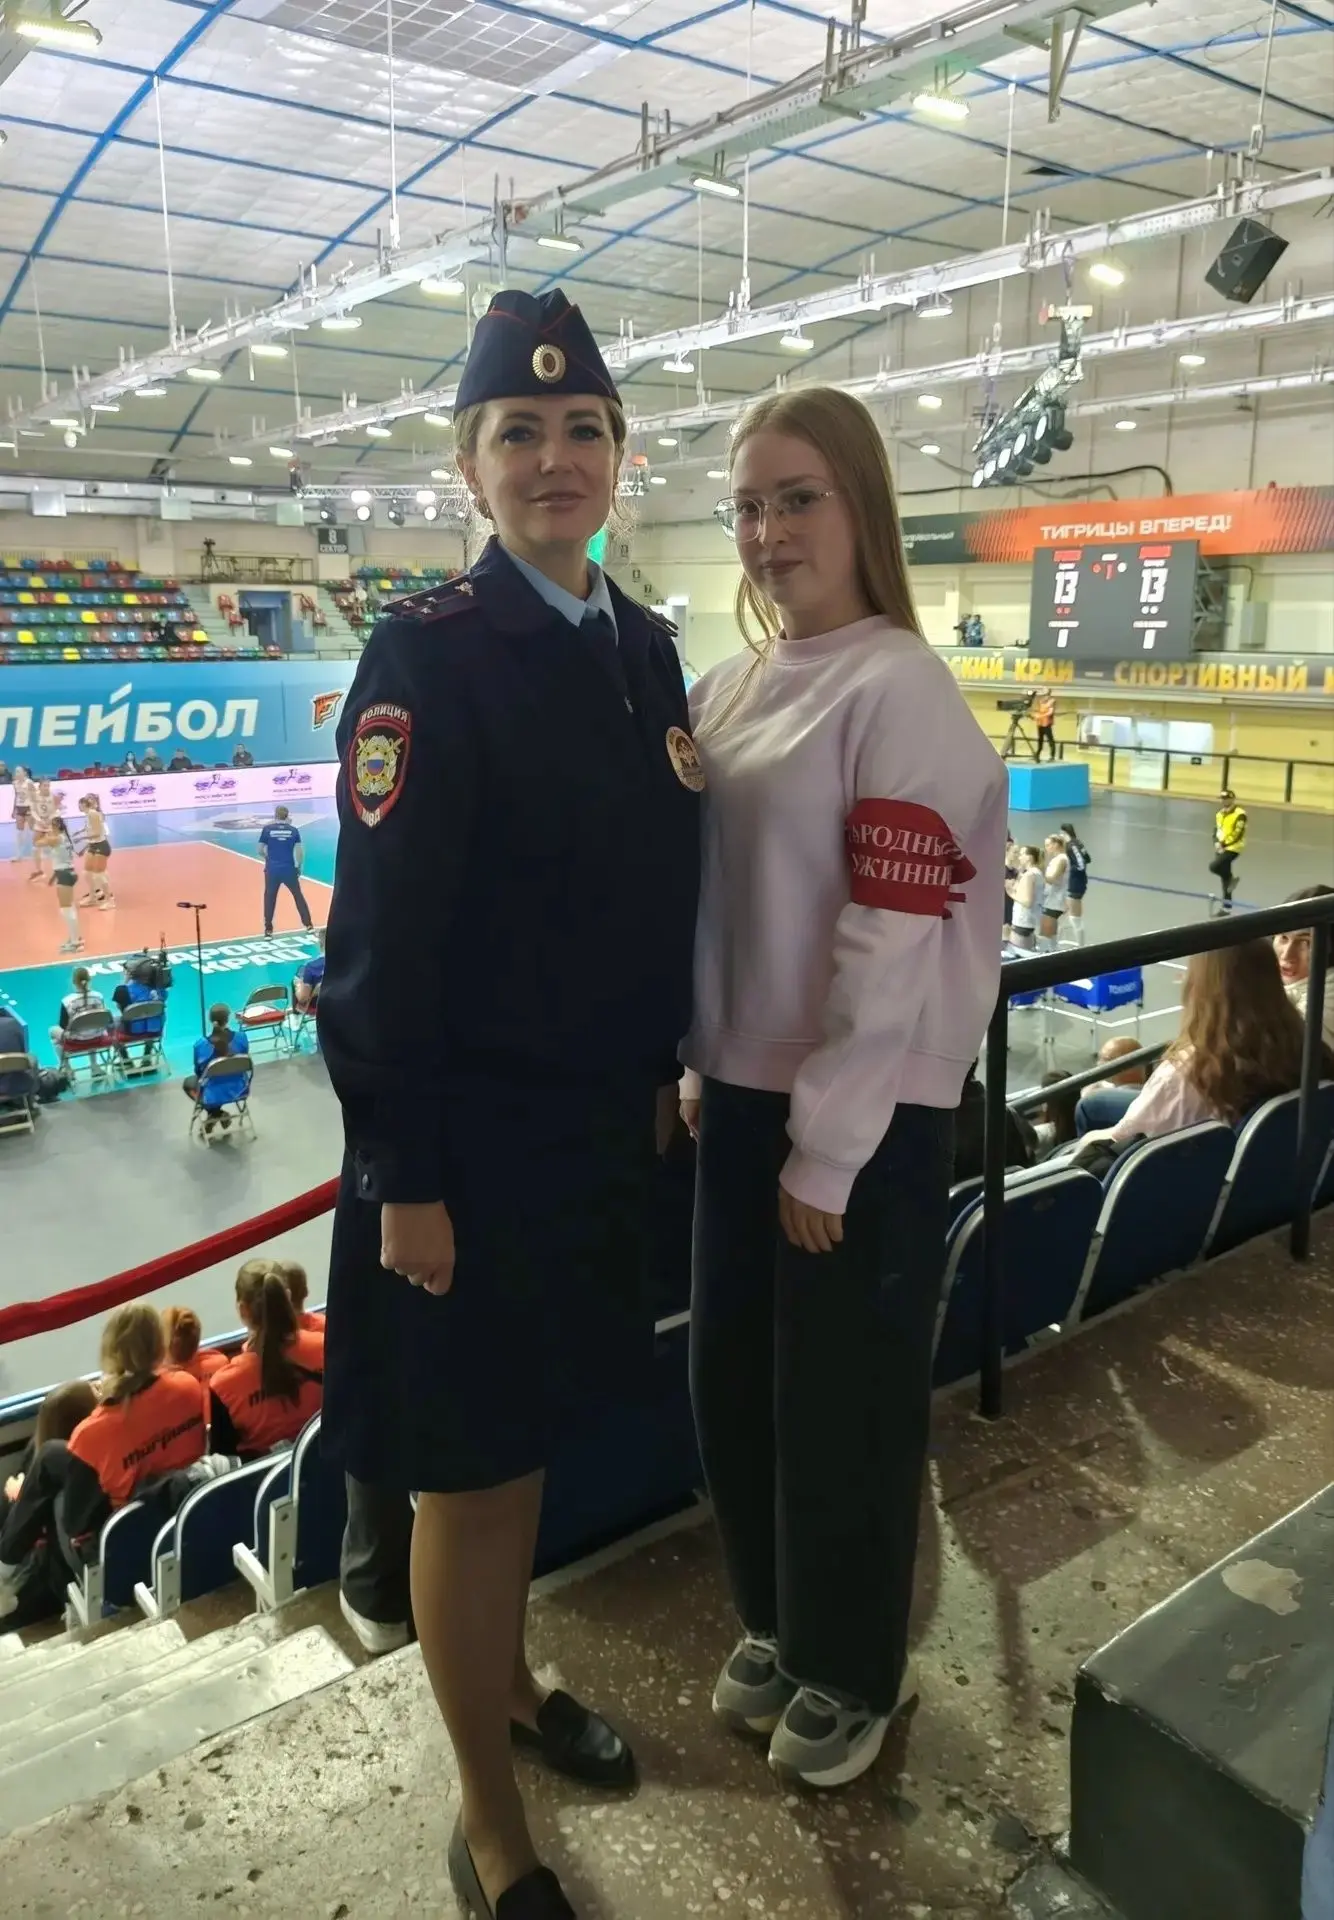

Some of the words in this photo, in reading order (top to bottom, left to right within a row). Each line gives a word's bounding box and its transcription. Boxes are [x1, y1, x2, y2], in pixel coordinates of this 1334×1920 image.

[1040, 521, 1135, 541] ТИГРИЦЫ
[1139, 514, 1232, 534] ВПЕРЕД!
[1053, 570, 1080, 604] 13
[1139, 567, 1168, 602] 13
[943, 651, 1004, 681] СКИЙ
[1113, 659, 1309, 694] СПОРТИВНЫЙ
[0, 682, 259, 749] ЛЕЙБОЛ
[360, 704, 408, 724] ПОЛИЦИЯ
[361, 807, 381, 828] МВД
